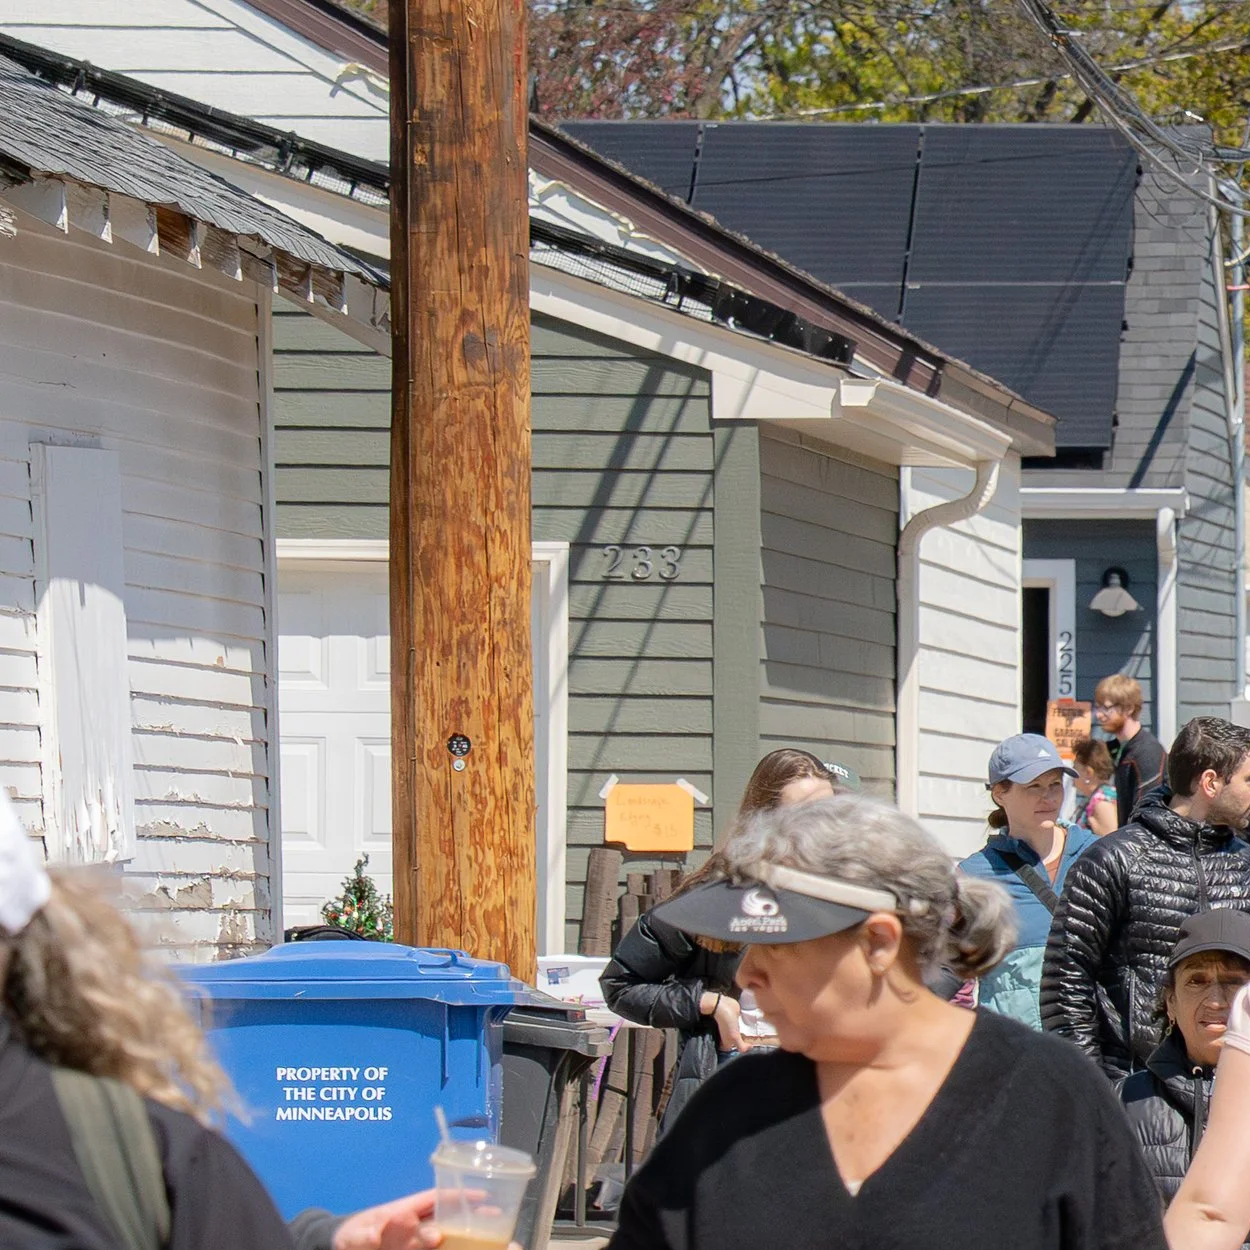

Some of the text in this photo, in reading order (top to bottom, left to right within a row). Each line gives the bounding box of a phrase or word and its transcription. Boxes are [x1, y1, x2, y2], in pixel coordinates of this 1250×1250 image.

[602, 545, 681, 580] 233
[1059, 631, 1073, 695] 225
[276, 1067, 388, 1081] PROPERTY OF
[283, 1087, 386, 1101] THE CITY OF
[276, 1107, 393, 1121] MINNEAPOLIS
